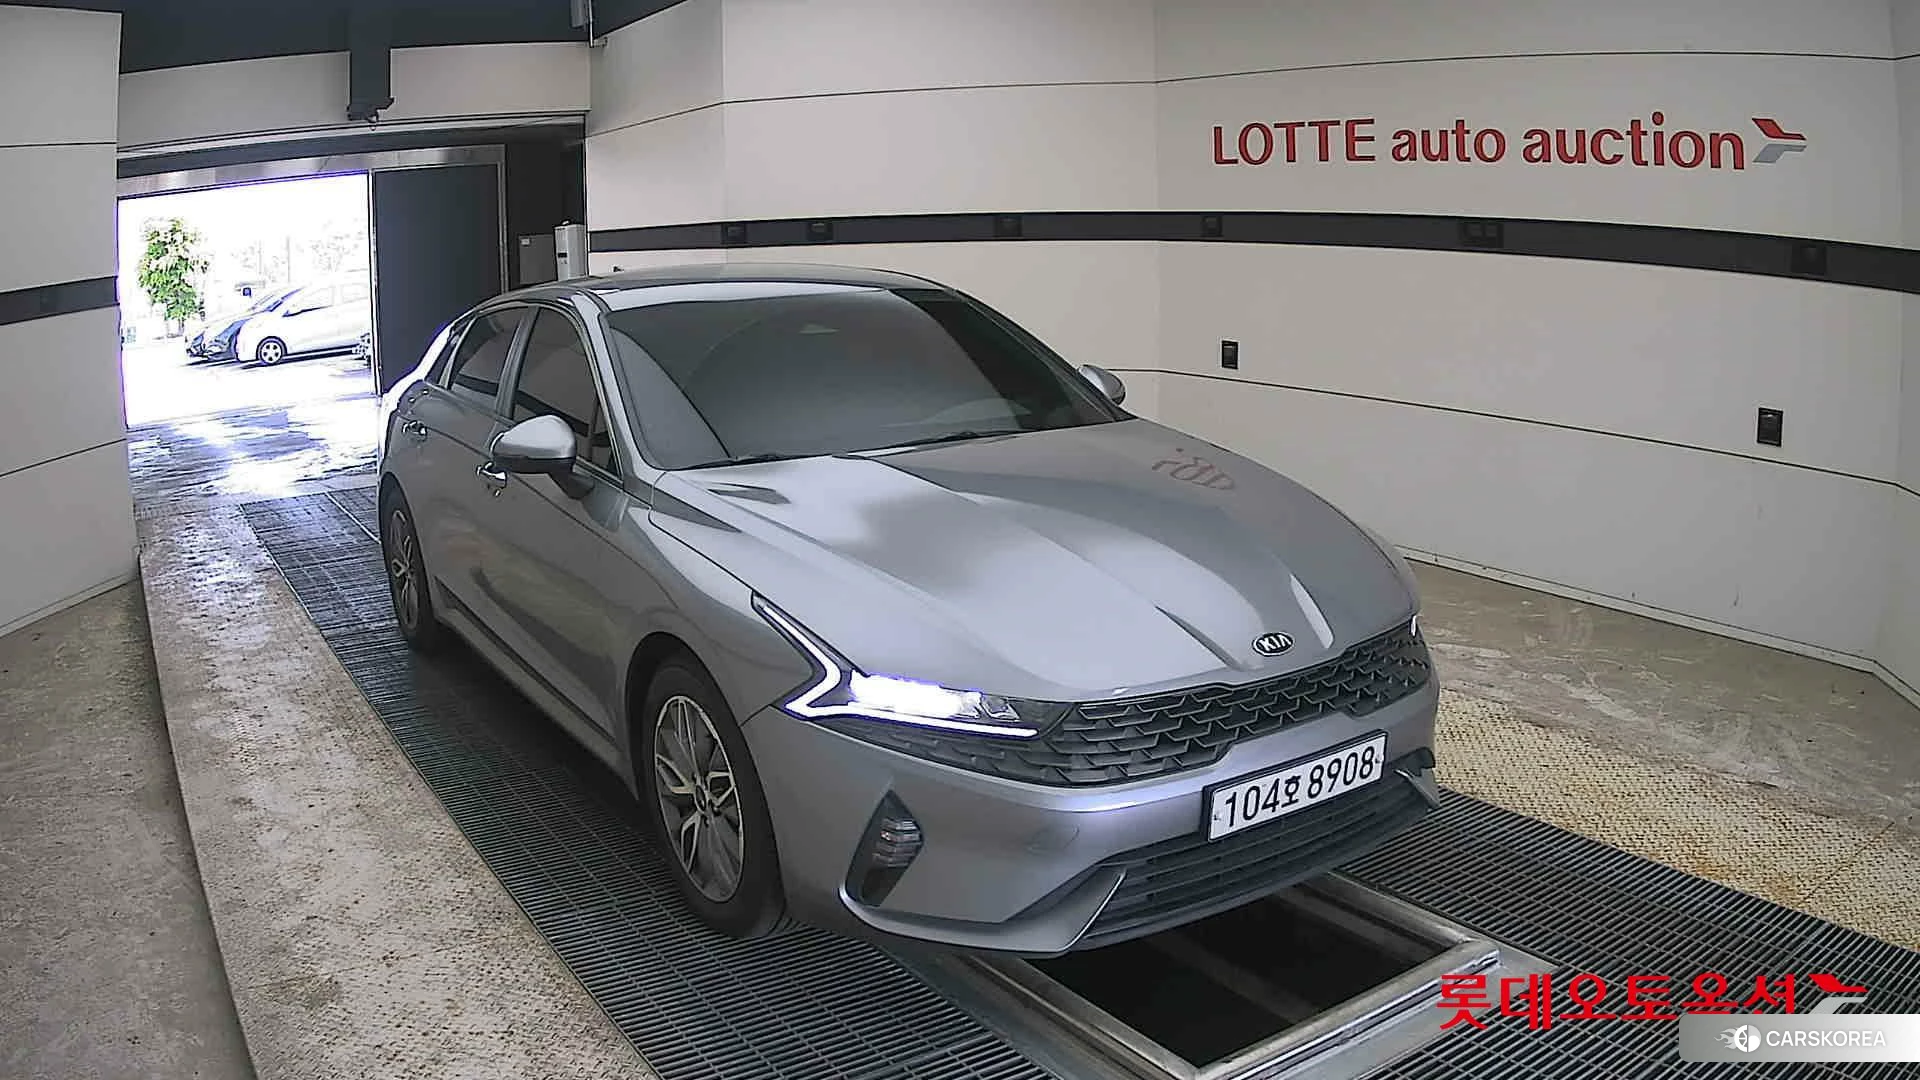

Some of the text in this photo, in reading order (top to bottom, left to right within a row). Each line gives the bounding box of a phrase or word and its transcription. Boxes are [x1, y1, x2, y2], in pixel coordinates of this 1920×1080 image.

[1213, 111, 1745, 170] LOTTE auto auction
[1258, 634, 1292, 651] KIA
[1307, 745, 1375, 799] 8908
